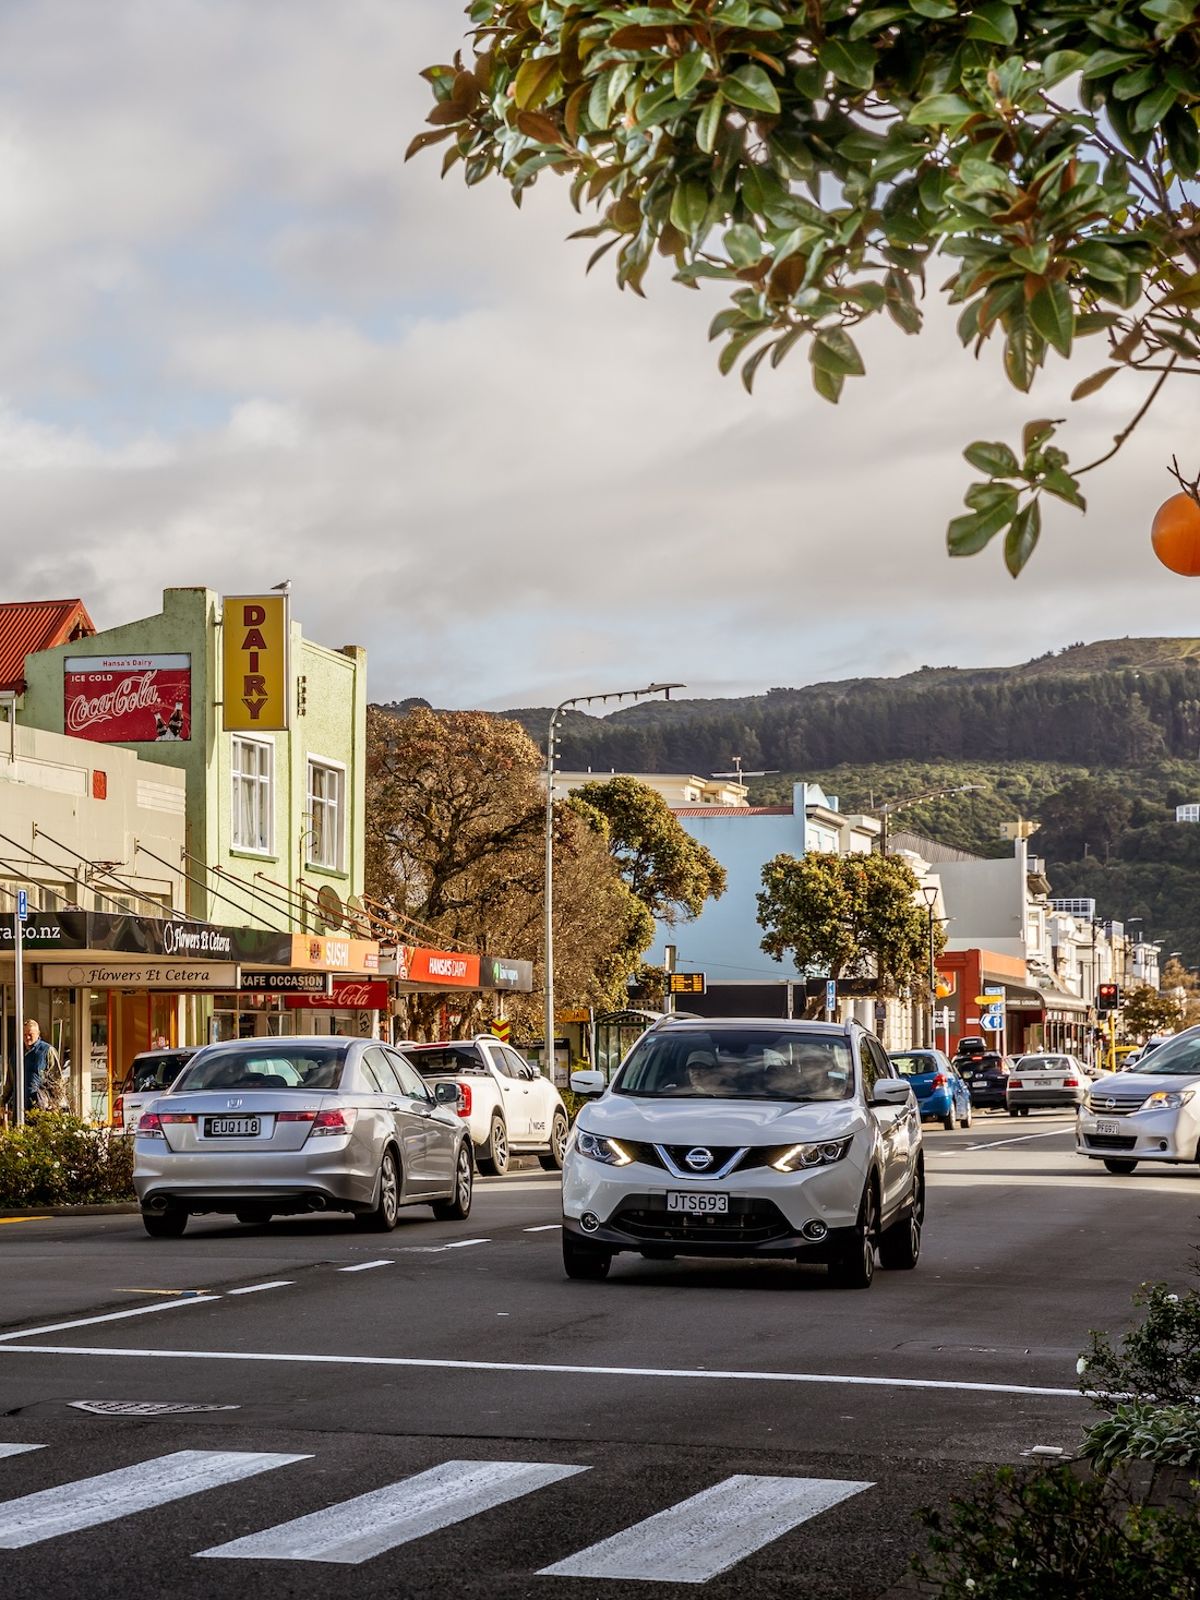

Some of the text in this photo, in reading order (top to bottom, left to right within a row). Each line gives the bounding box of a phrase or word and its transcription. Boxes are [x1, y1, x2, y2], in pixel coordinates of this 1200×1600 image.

[102, 658, 152, 668] Hansa's Dairy
[241, 604, 268, 720] DAIRY
[71, 674, 113, 683] ICE COLD
[173, 925, 230, 952] Flowers Et Cetera
[325, 942, 349, 967] SUSHI
[87, 968, 210, 984] Flowers Et Cetera
[452, 960, 467, 977] DAIRY
[241, 976, 323, 986] KAFE OCCASION
[213, 1120, 258, 1133] EUQ118
[669, 1195, 727, 1211] JTS693
